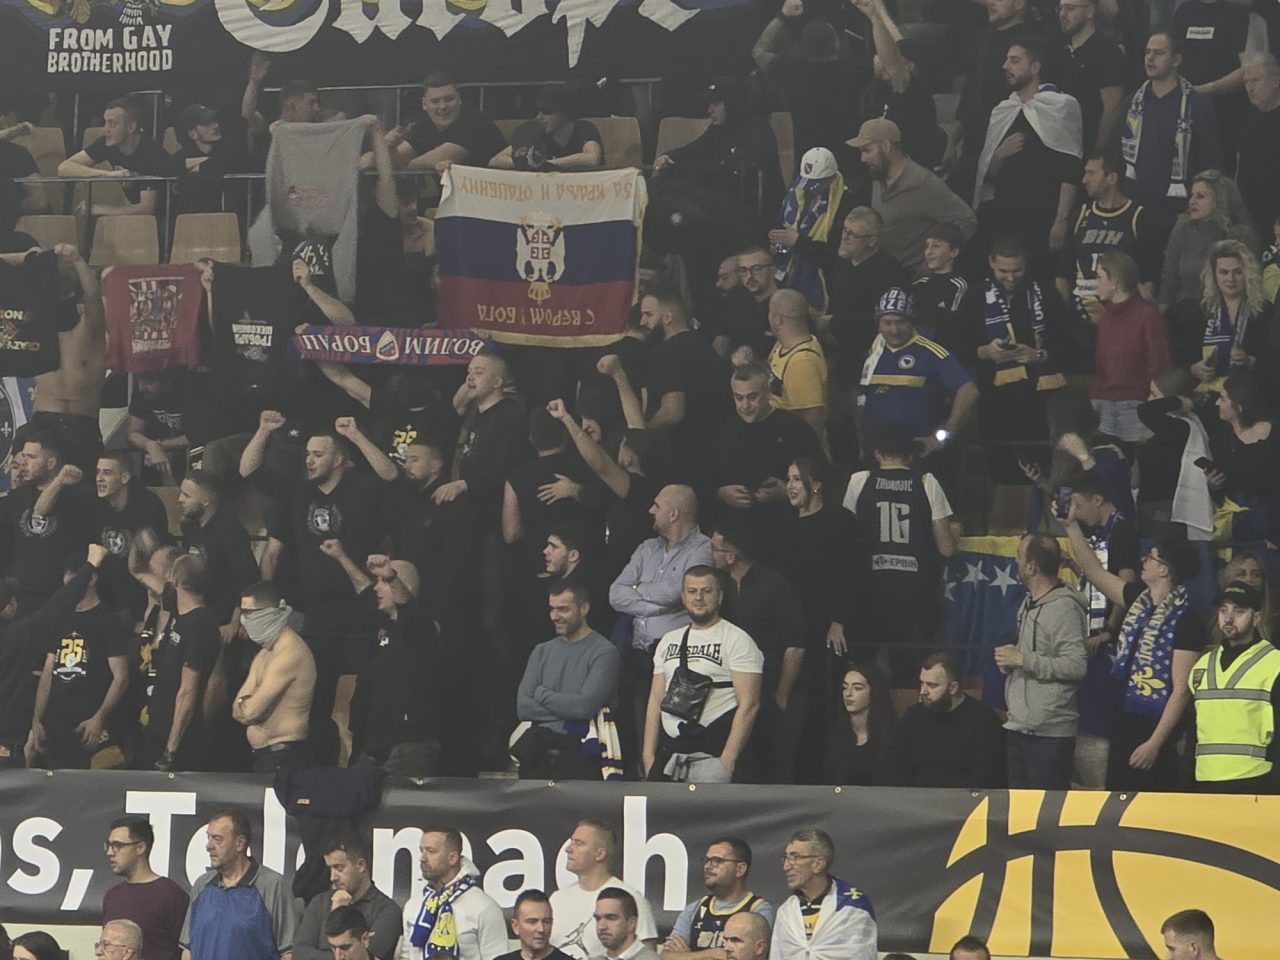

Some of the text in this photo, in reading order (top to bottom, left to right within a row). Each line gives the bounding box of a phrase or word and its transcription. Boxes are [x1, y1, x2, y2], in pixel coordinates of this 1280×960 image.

[49, 24, 173, 50] FROM GAY
[47, 49, 173, 73] BROTHERHOOD
[540, 185, 549, 201] И
[612, 182, 632, 200] ЗА
[1091, 252, 1105, 272] 1
[476, 304, 516, 324] БОГА
[530, 308, 581, 326] ВЕРОМ
[301, 334, 484, 356] ВОЛИМ БОРАЦ
[876, 501, 910, 544] 16
[60, 639, 84, 664] 25
[666, 643, 721, 661] LOSDALE
[126, 787, 689, 911] Tlmah
